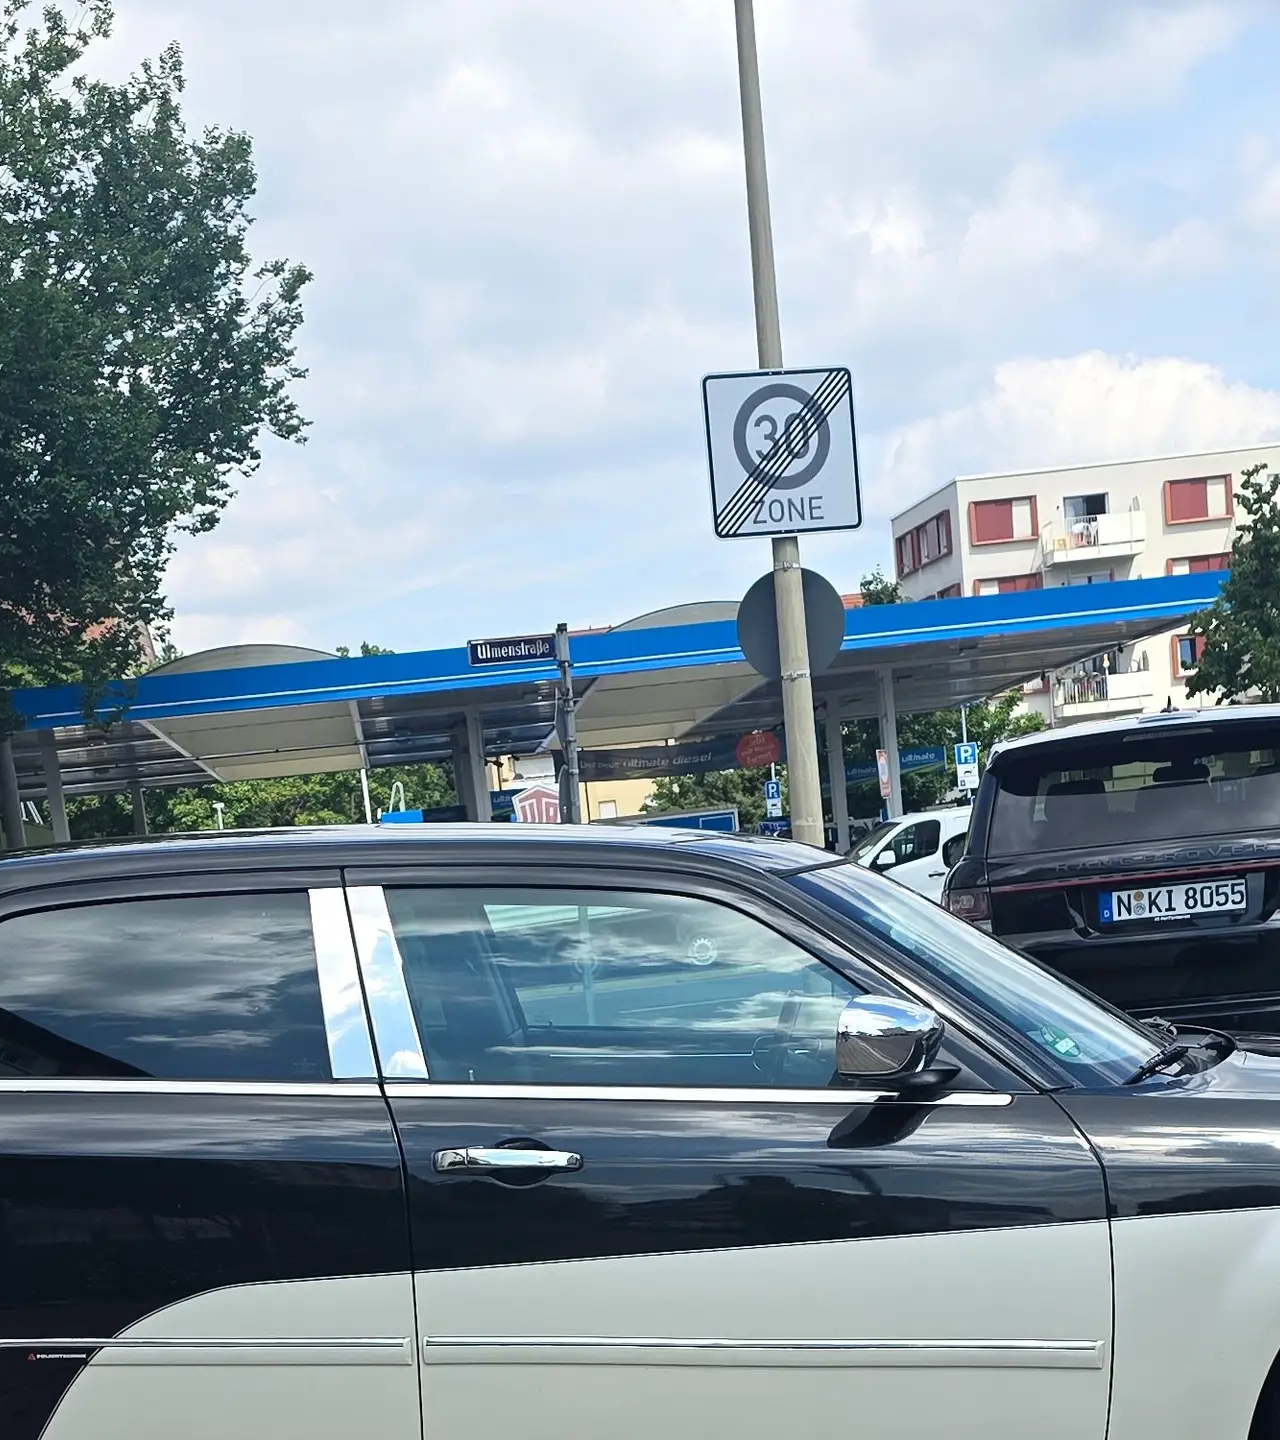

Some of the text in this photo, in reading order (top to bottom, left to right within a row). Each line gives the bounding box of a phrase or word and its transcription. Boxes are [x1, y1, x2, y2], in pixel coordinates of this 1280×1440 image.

[753, 412, 811, 462] 30
[752, 495, 825, 525] ZONE
[477, 640, 550, 659] Ulmenstraße
[623, 756, 670, 768] ultimate
[672, 752, 712, 765] diesel
[901, 752, 935, 763] ultimate
[1055, 844, 1268, 872] RANGE ROVER
[1116, 893, 1132, 918] N
[1148, 889, 1176, 914] KI
[1184, 882, 1245, 910] 8055
